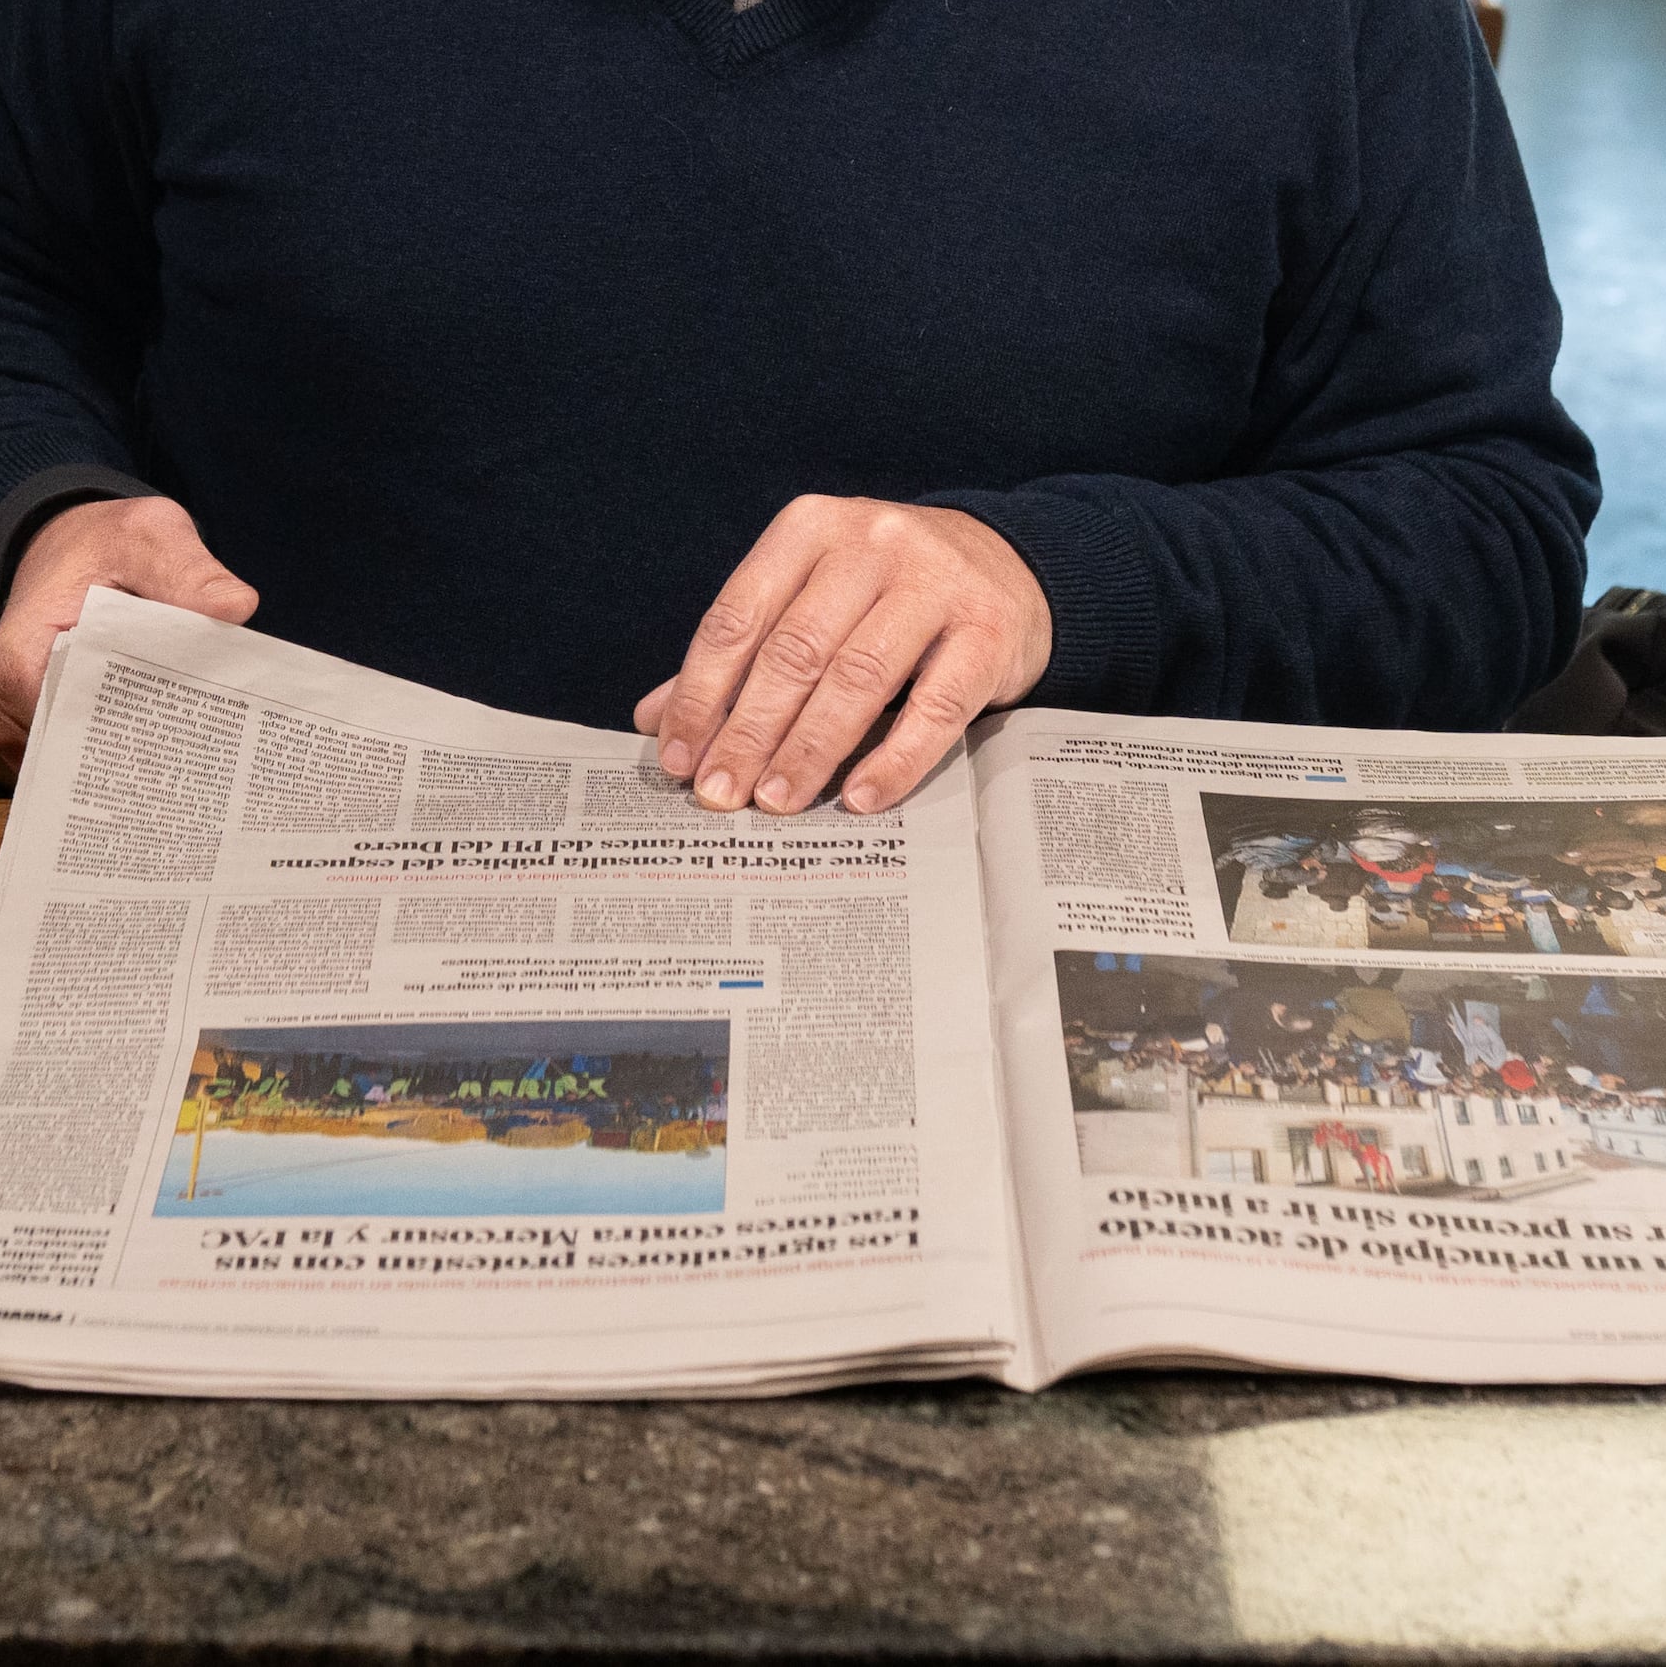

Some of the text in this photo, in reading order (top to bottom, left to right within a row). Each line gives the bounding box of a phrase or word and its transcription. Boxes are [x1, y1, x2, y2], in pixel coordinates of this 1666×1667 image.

[105, 659, 250, 711] agua vinculadas a las renovables.
[103, 671, 247, 722] urbanas y nuevas demandas de
[100, 682, 245, 733] tamientos de aguas residuales
[1028, 755, 1100, 765] miembros
[1058, 747, 1345, 775] de la comisión deberán responder con sus
[1064, 738, 1343, 766] bienes personales para afrontar la deuda
[1101, 758, 1123, 769] los
[1124, 760, 1185, 772] acuerdo,
[1187, 766, 1207, 775] un
[1219, 769, 1263, 780] llegan
[1285, 773, 1300, 782] Si
[353, 836, 906, 855] de temas importantes del PH del Duero
[269, 852, 907, 872] Sigue abierta la consulta pública del esquema
[325, 874, 400, 884] definitivo
[402, 873, 495, 884] documento
[498, 872, 513, 883] el
[516, 872, 608, 883] consolidará
[634, 871, 737, 882] presentadas,
[740, 871, 845, 883] aportaciones
[848, 871, 871, 880] las
[874, 870, 908, 879] Con
[1107, 1188, 1234, 1218] juicio
[1244, 1196, 1270, 1215] a
[1281, 1200, 1320, 1226] ir
[1329, 1204, 1397, 1232] sin
[200, 1207, 920, 1249] tractores contra Mercosur y la PAC
[1099, 1219, 1283, 1248] acuerdo
[1406, 1211, 1572, 1240] premio
[1581, 1223, 1634, 1241] su
[848, 1231, 919, 1248] Los
[1295, 1233, 1350, 1261] de
[587, 1235, 837, 1269] agricultores
[1360, 1240, 1571, 1274] principio
[214, 1256, 281, 1271] sus
[292, 1256, 366, 1271] con
[377, 1251, 577, 1275] protestan
[1580, 1254, 1644, 1272] un
